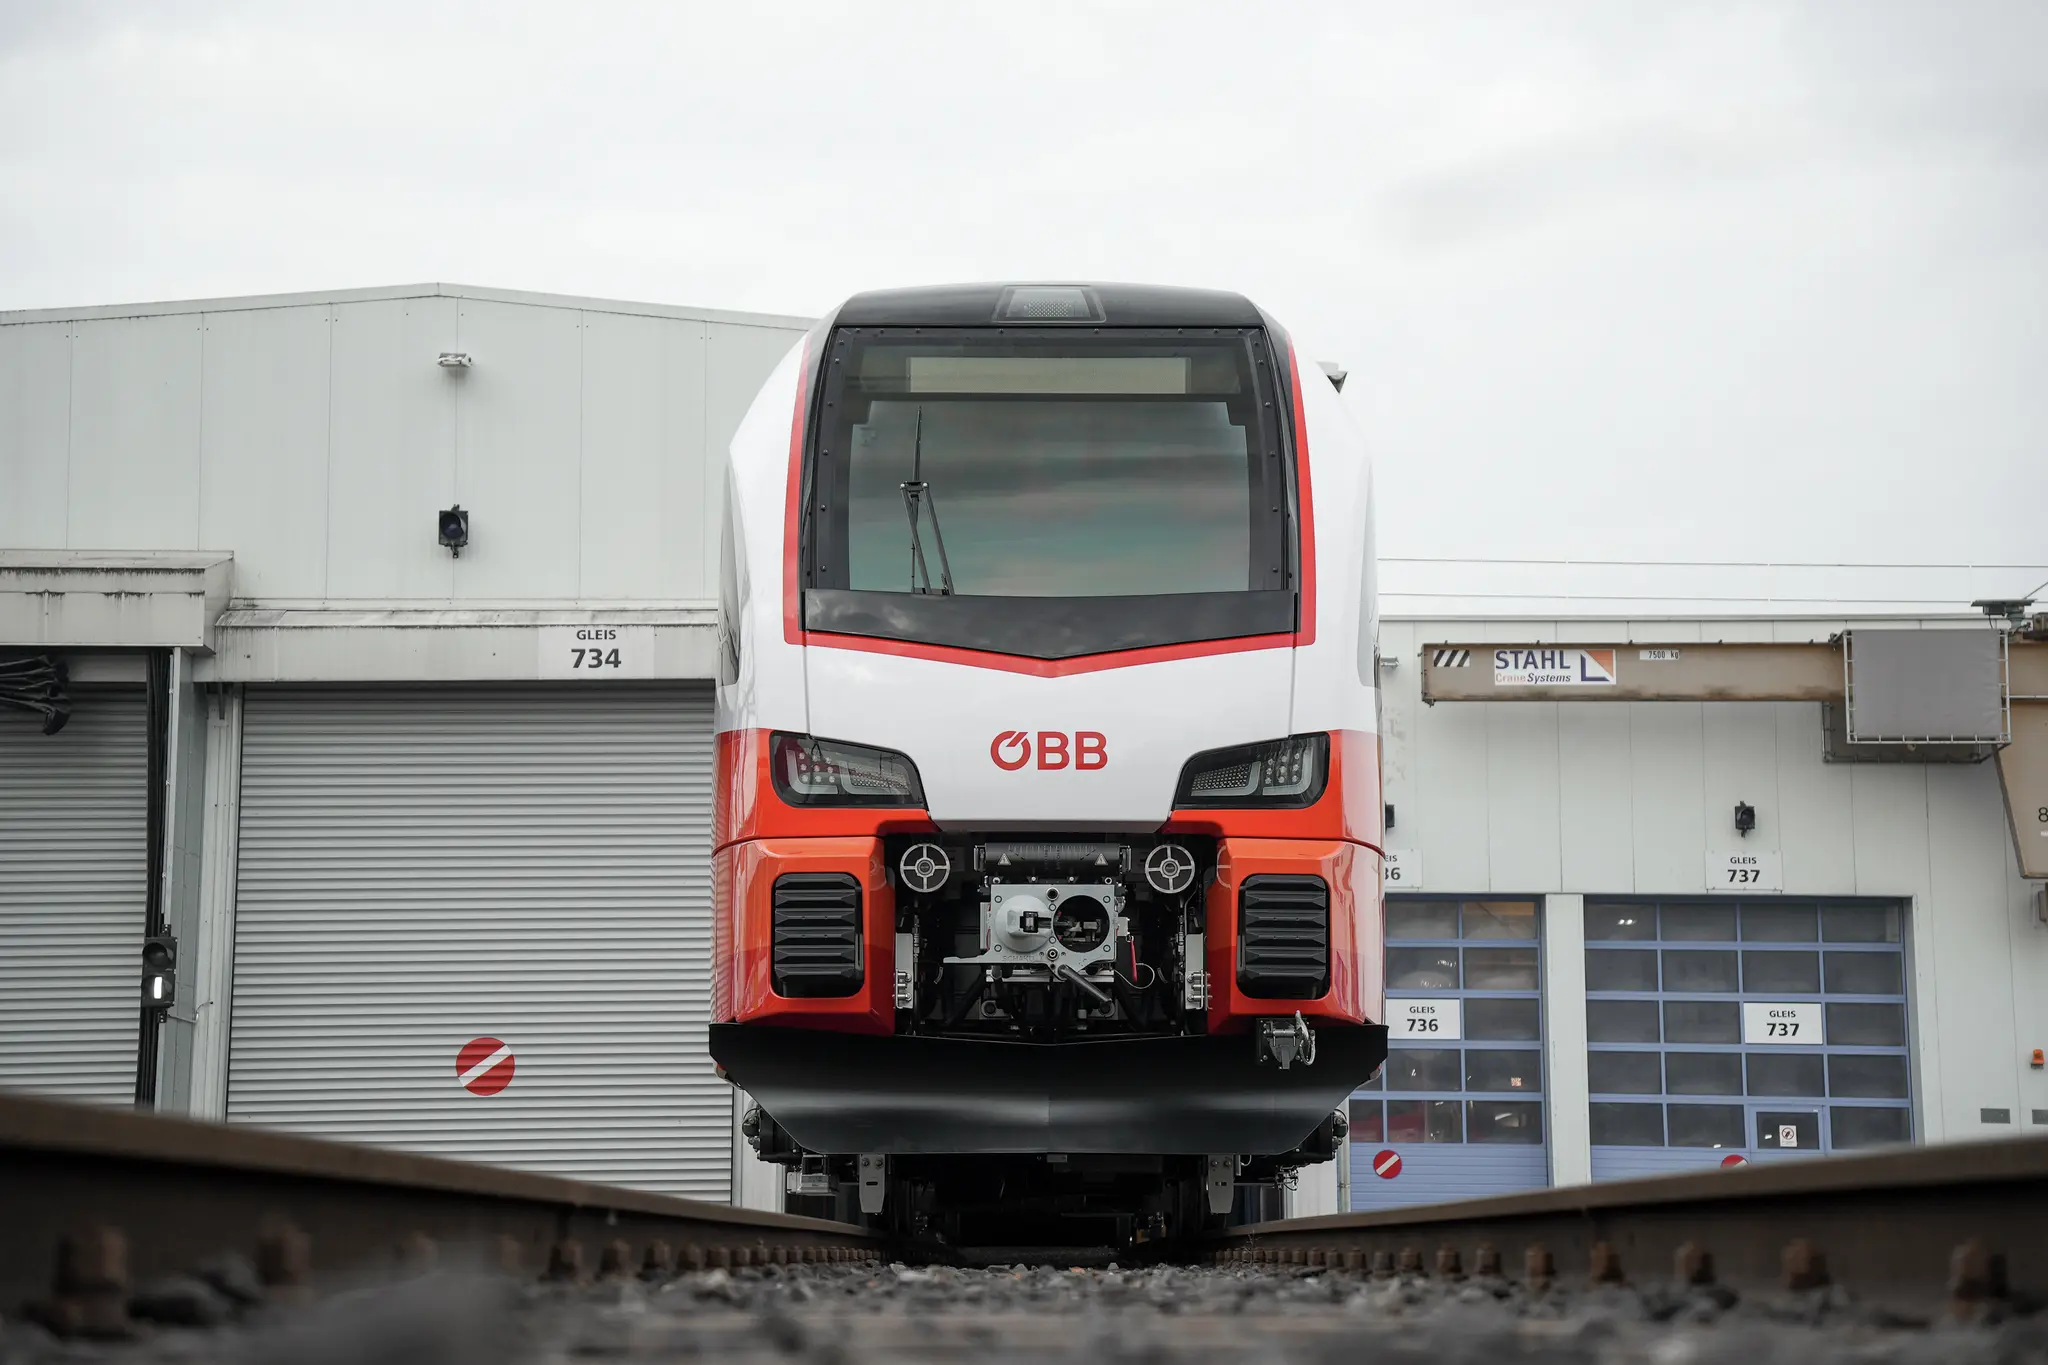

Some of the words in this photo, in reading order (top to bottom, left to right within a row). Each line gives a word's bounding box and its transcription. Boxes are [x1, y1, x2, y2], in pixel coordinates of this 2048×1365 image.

[576, 629, 616, 640] GLEIS
[571, 648, 621, 669] 734
[1495, 649, 1571, 670] STAHL
[1648, 650, 1666, 659] 7500
[1670, 650, 1679, 660] kg
[1730, 856, 1757, 865] GLEIS
[1727, 869, 1761, 883] 737
[1409, 1006, 1435, 1014] GLEIS
[1769, 1010, 1796, 1018] GLEIS
[1406, 1018, 1439, 1032] 736
[1766, 1022, 1800, 1037] 737
